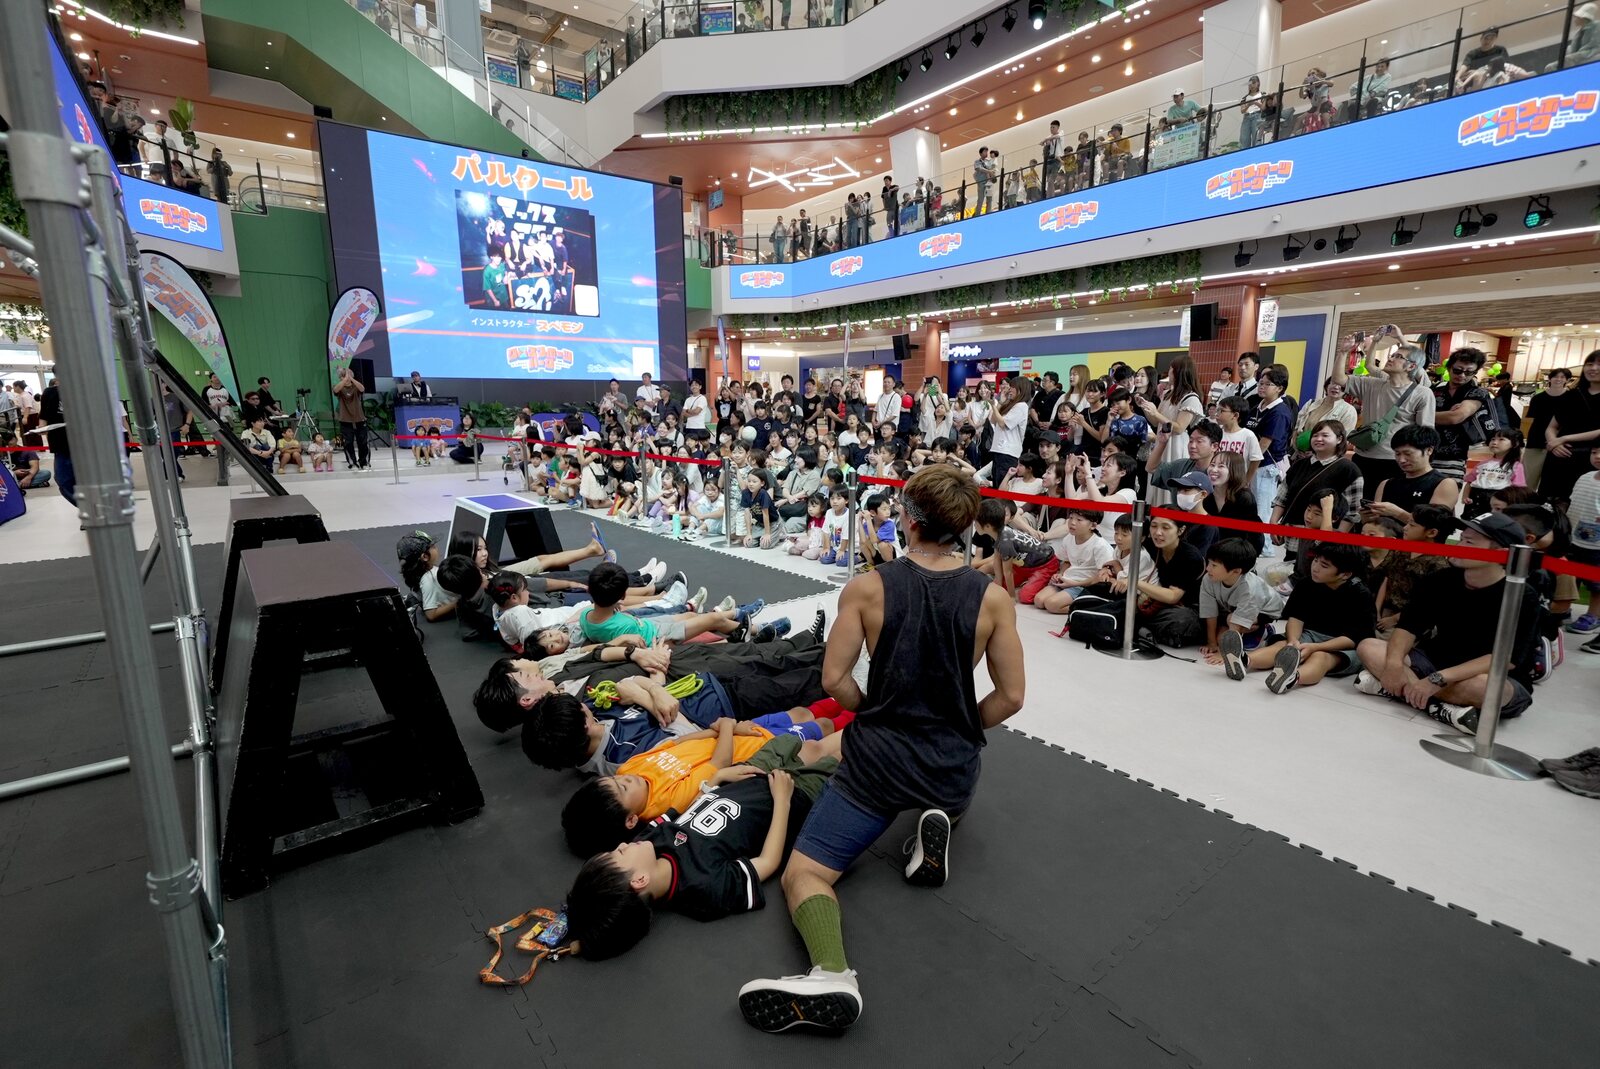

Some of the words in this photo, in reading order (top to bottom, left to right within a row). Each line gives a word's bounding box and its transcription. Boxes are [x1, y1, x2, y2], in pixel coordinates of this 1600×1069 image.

[472, 317, 531, 328] インストラクター
[749, 359, 760, 367] GU
